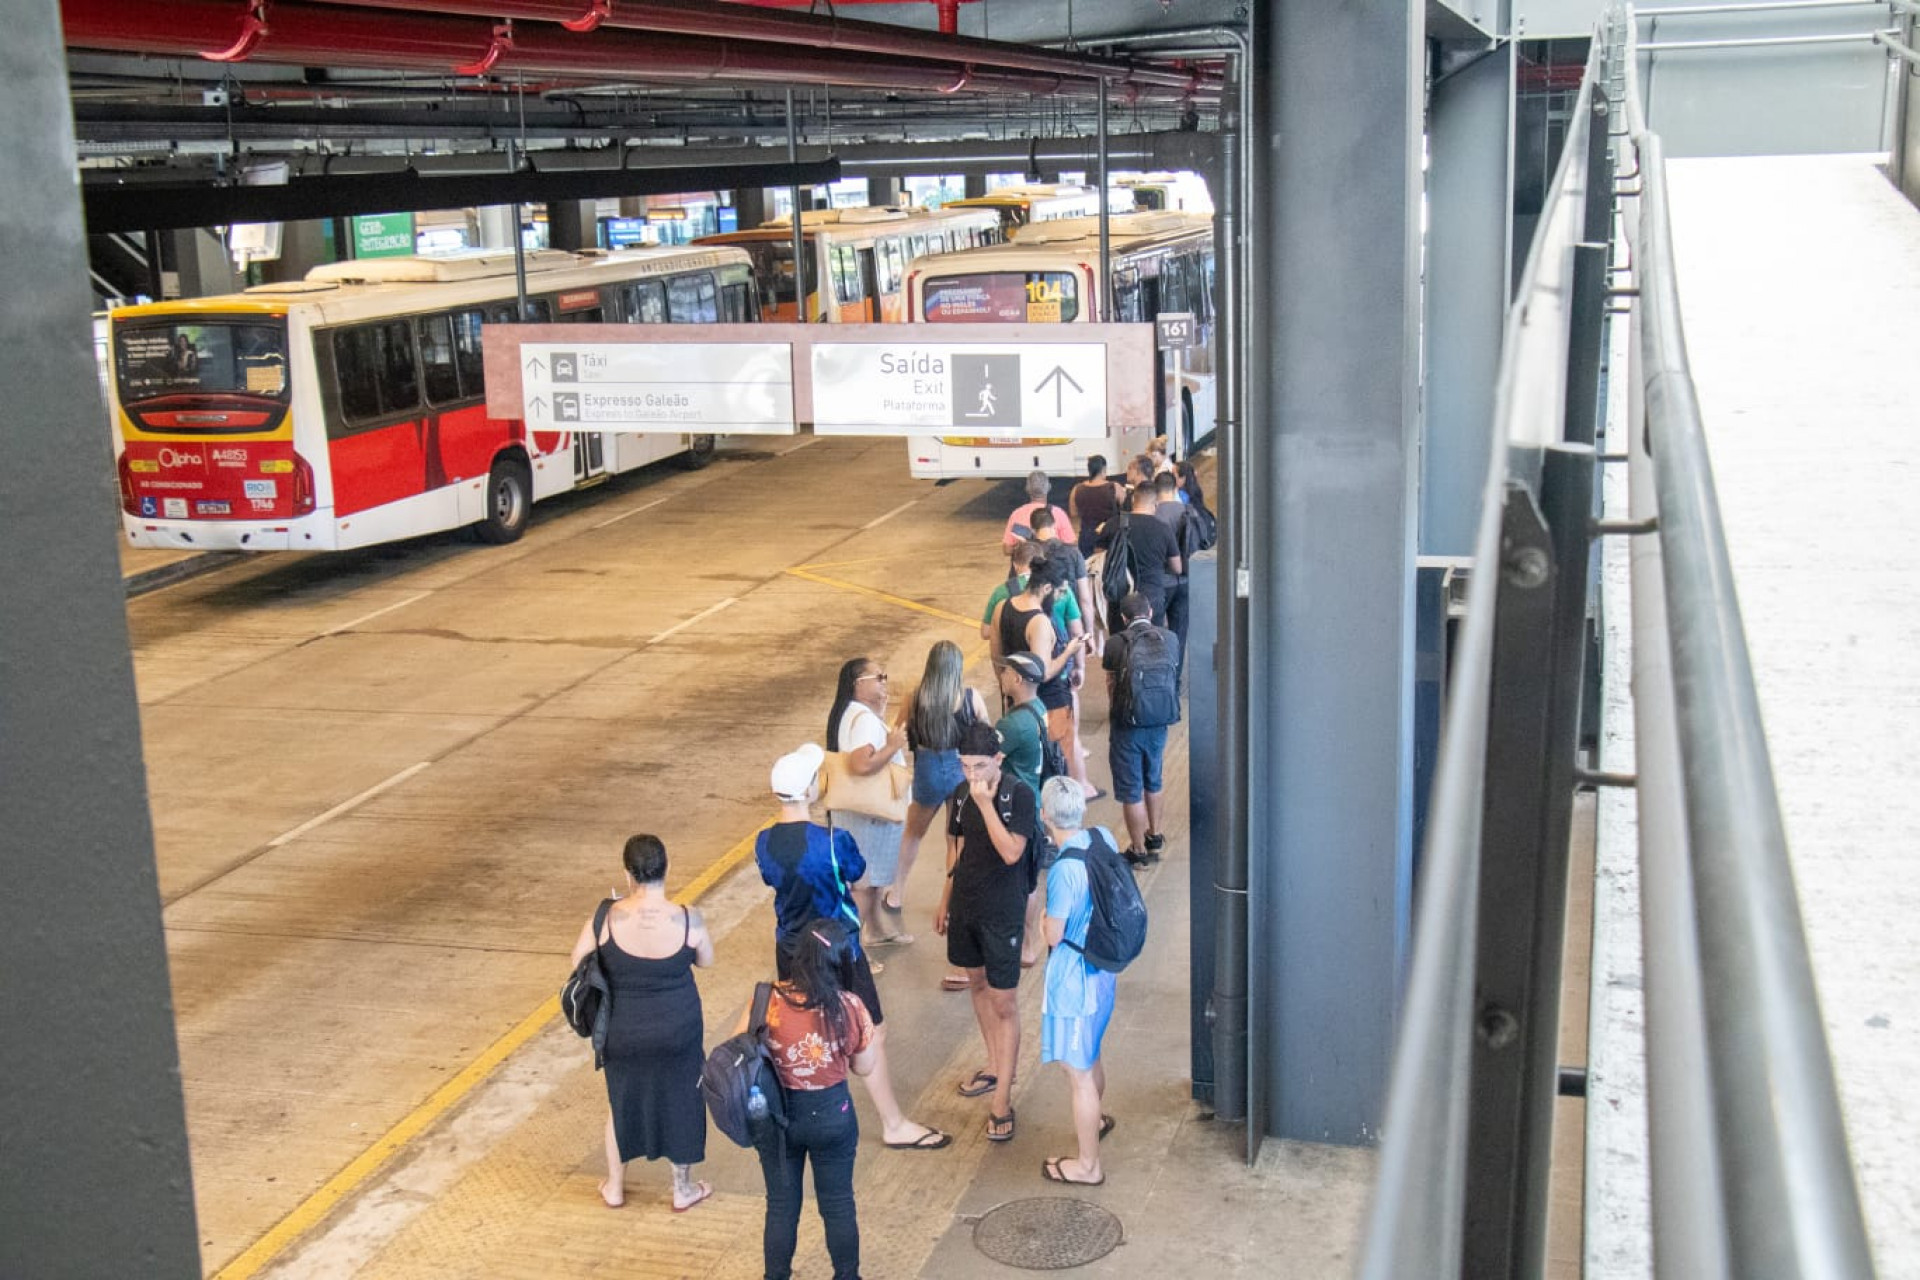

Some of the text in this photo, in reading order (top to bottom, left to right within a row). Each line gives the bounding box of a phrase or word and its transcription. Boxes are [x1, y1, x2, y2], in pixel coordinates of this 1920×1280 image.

[1025, 281, 1063, 303] 104
[1162, 322, 1187, 337] 161
[582, 353, 607, 368] Táxi
[880, 350, 944, 374] Saída
[914, 379, 944, 394] Exit
[584, 392, 689, 408] Expresso Galeão
[883, 399, 946, 411] Plataforma
[246, 483, 264, 492] RIO
